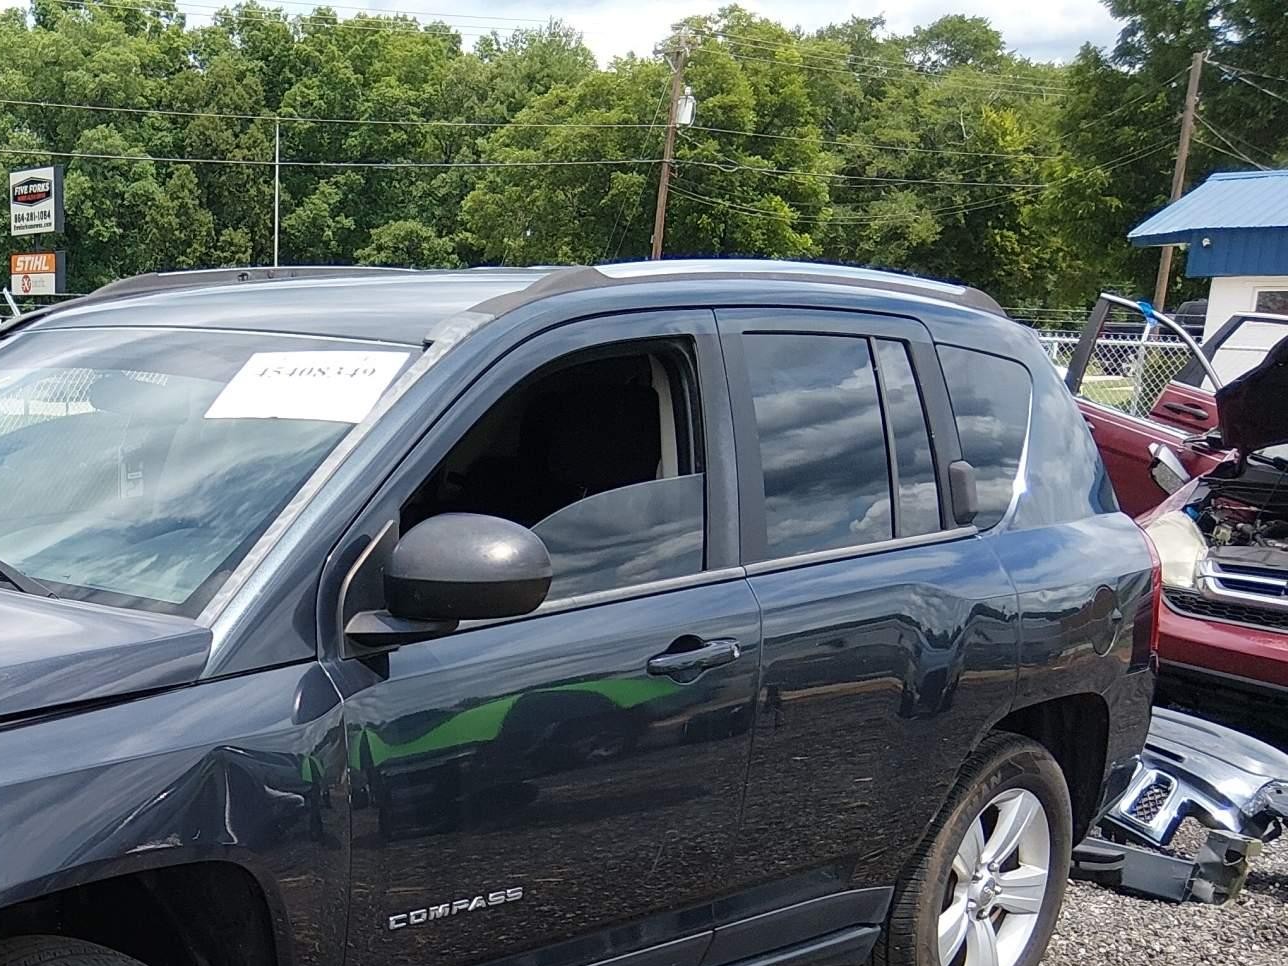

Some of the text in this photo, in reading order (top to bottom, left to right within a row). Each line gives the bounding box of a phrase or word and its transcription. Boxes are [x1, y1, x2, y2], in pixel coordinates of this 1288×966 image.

[14, 182, 50, 196] FIVE FORKS
[15, 255, 50, 271] STIHL
[389, 886, 524, 930] COMPASS
